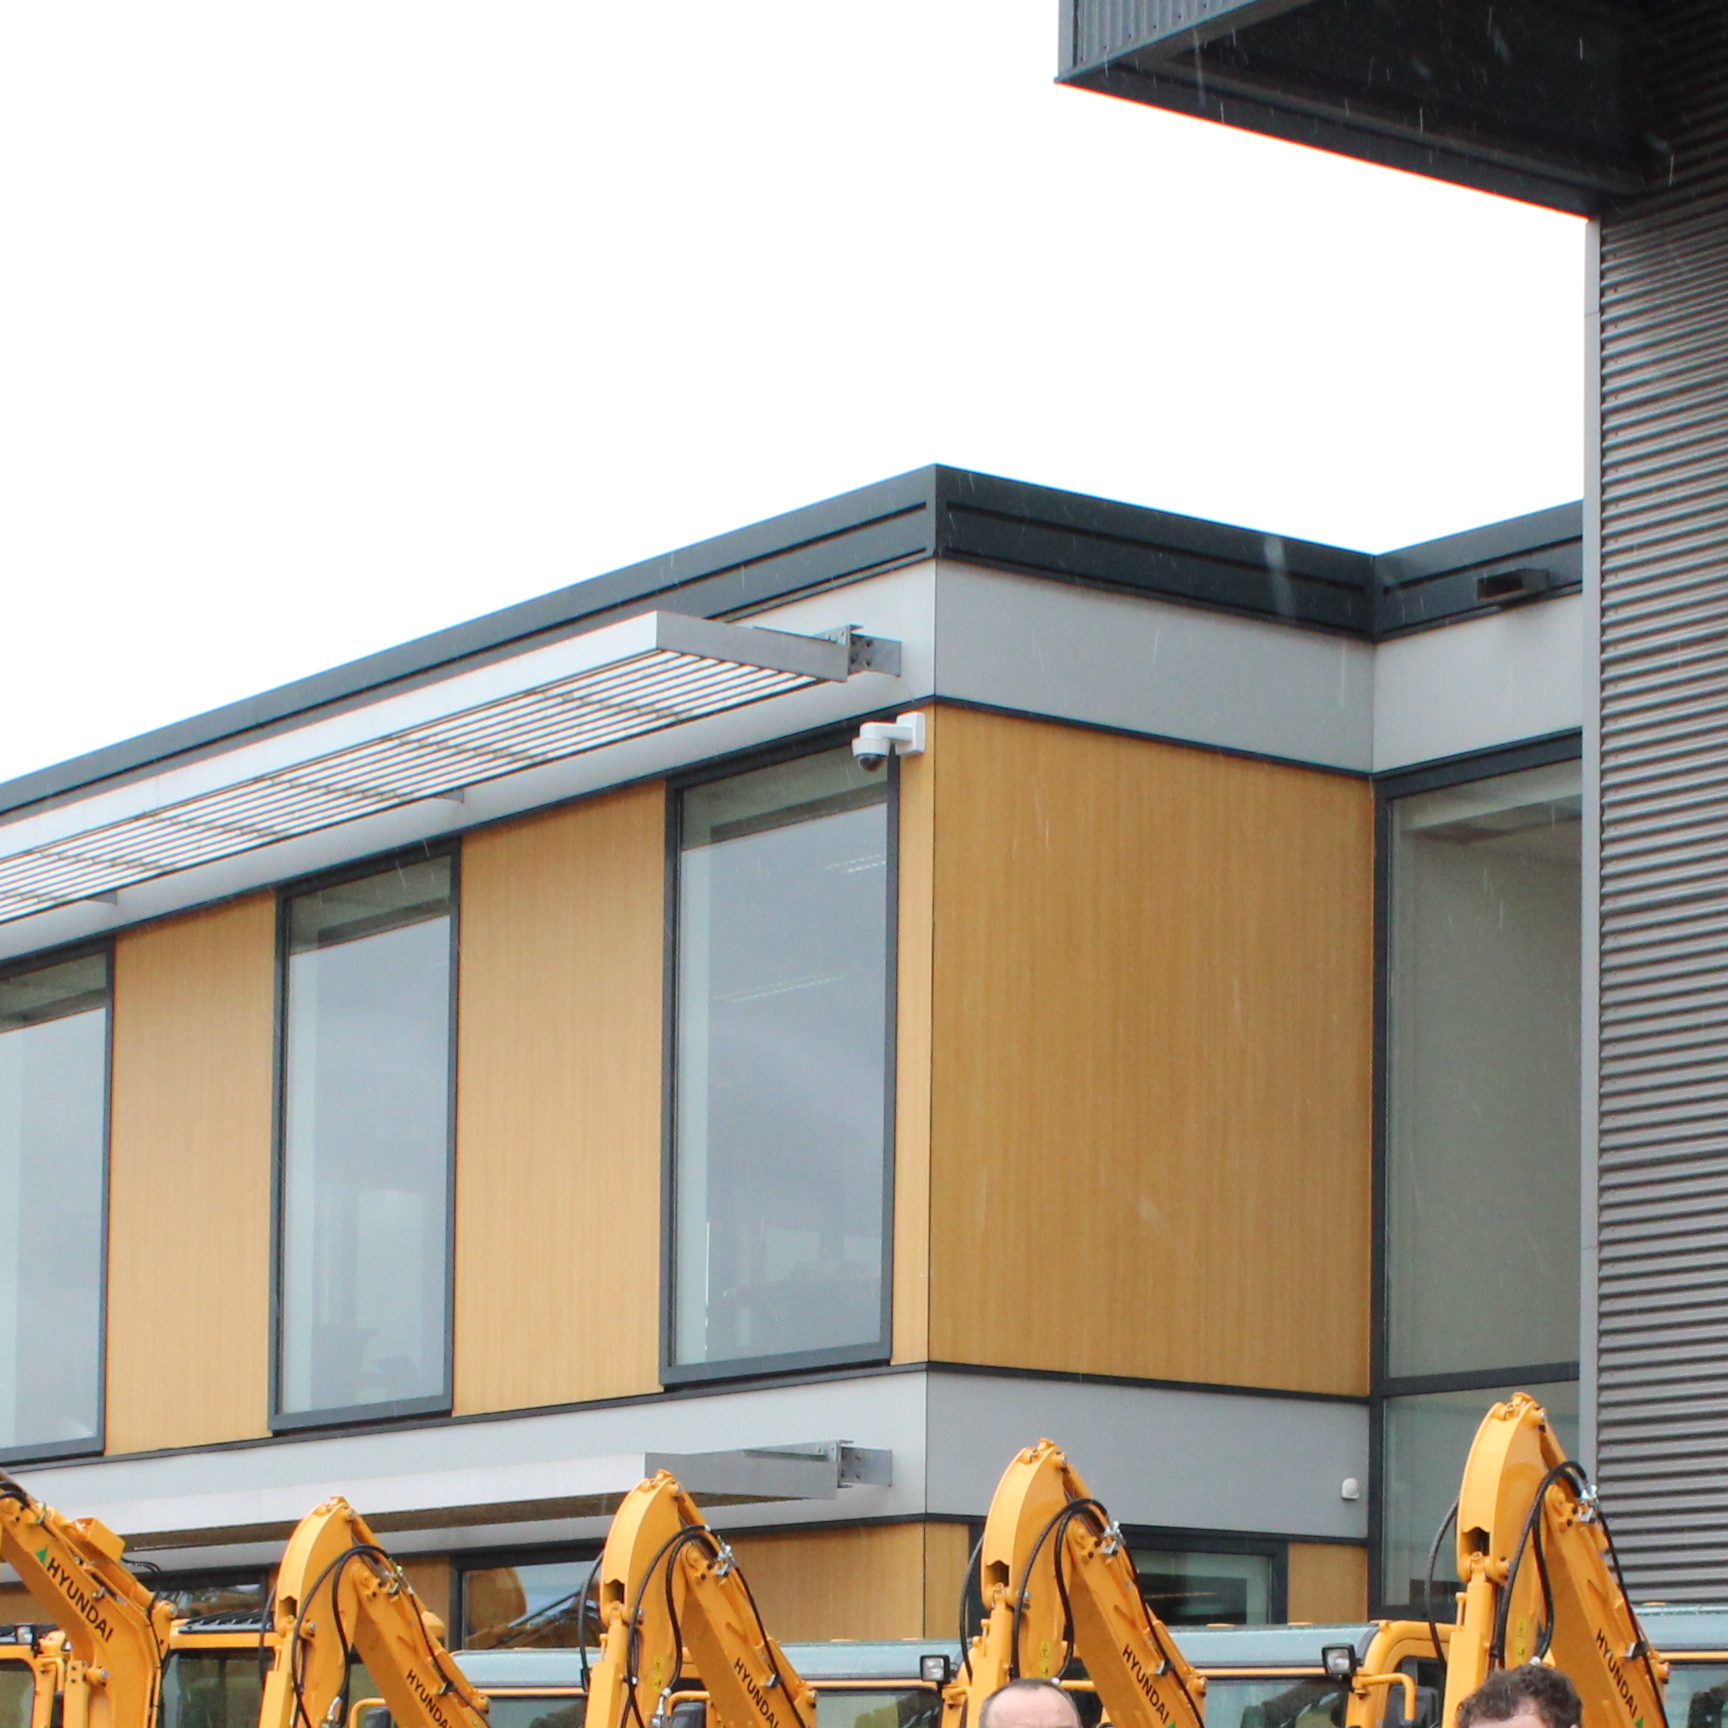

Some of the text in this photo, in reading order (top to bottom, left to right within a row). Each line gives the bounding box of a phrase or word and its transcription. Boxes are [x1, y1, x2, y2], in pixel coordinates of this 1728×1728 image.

[46, 1557, 114, 1643] HYUNDAI
[1122, 1644, 1170, 1725] HYUNDAI
[1596, 1628, 1638, 1719] HYUNDAI
